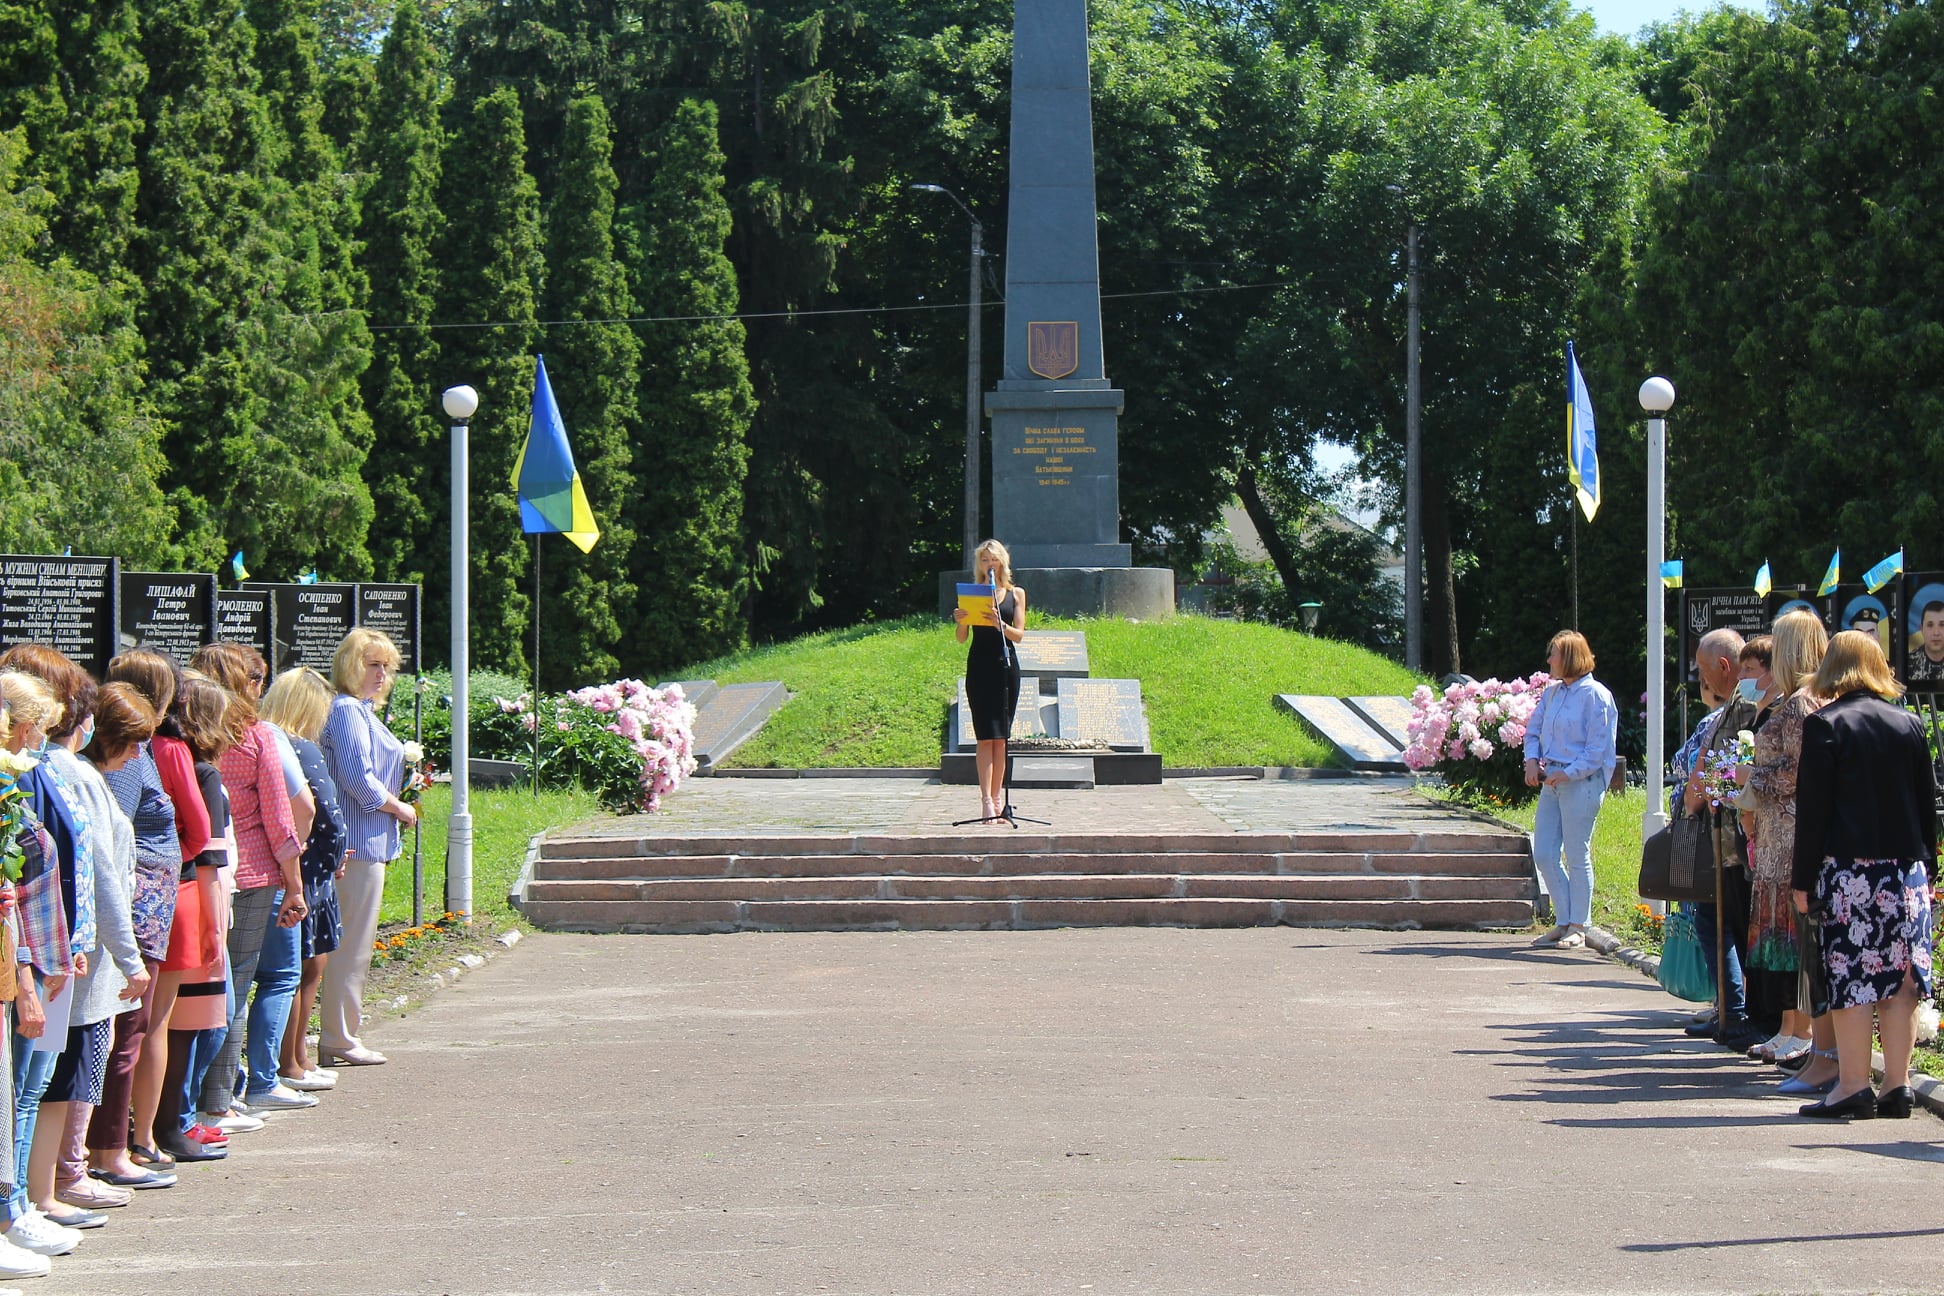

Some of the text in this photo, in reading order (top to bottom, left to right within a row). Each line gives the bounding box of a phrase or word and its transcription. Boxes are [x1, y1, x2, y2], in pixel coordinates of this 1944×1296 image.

[4, 562, 38, 574] МУЖНІМ
[39, 563, 65, 575] СИНАМ
[6, 576, 36, 588] вірними
[146, 584, 196, 597] ЛИШАФАЙ
[364, 591, 407, 600] САПОНЕНКО
[298, 593, 342, 604] ОСИПЕНКО
[1712, 596, 1762, 606] ВІЧНА ПАМ'ЯТЬ
[38, 604, 56, 614] Сергій
[157, 598, 186, 611] Петро
[217, 600, 263, 611] РМОЛЕНКО
[313, 604, 328, 613] Іван
[379, 601, 392, 609] Іван
[152, 610, 190, 620] Іванович
[224, 612, 251, 624] Андрій
[298, 614, 342, 623] Степанович
[368, 610, 402, 620] Федорович
[20, 620, 51, 630] Володимир
[217, 623, 257, 634] Давидович
